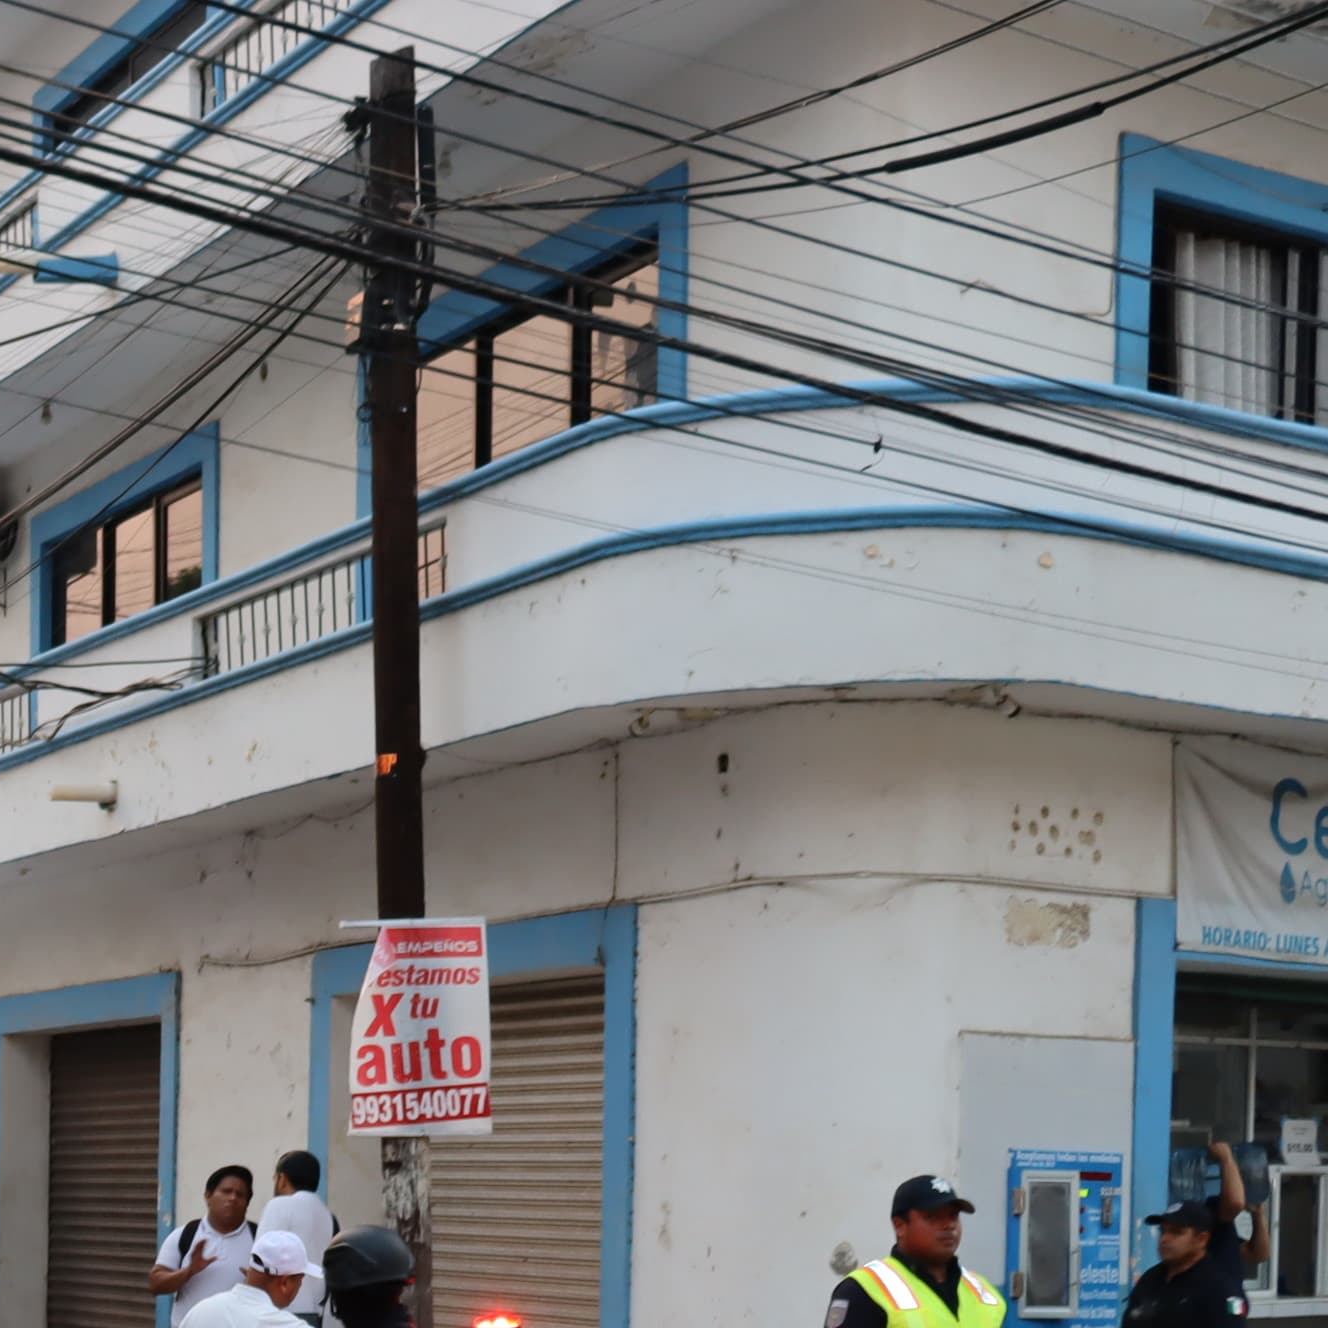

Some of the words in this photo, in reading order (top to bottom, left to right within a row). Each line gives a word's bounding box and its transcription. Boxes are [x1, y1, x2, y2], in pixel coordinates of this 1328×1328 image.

[1201, 925, 1272, 950] HORARIO:
[1276, 933, 1320, 956] LUNES
[369, 964, 481, 988] estamos
[410, 994, 440, 1019] tu
[356, 1028, 482, 1087] auto
[352, 1087, 488, 1125] 9931540077
[1079, 1264, 1119, 1283] eleste
